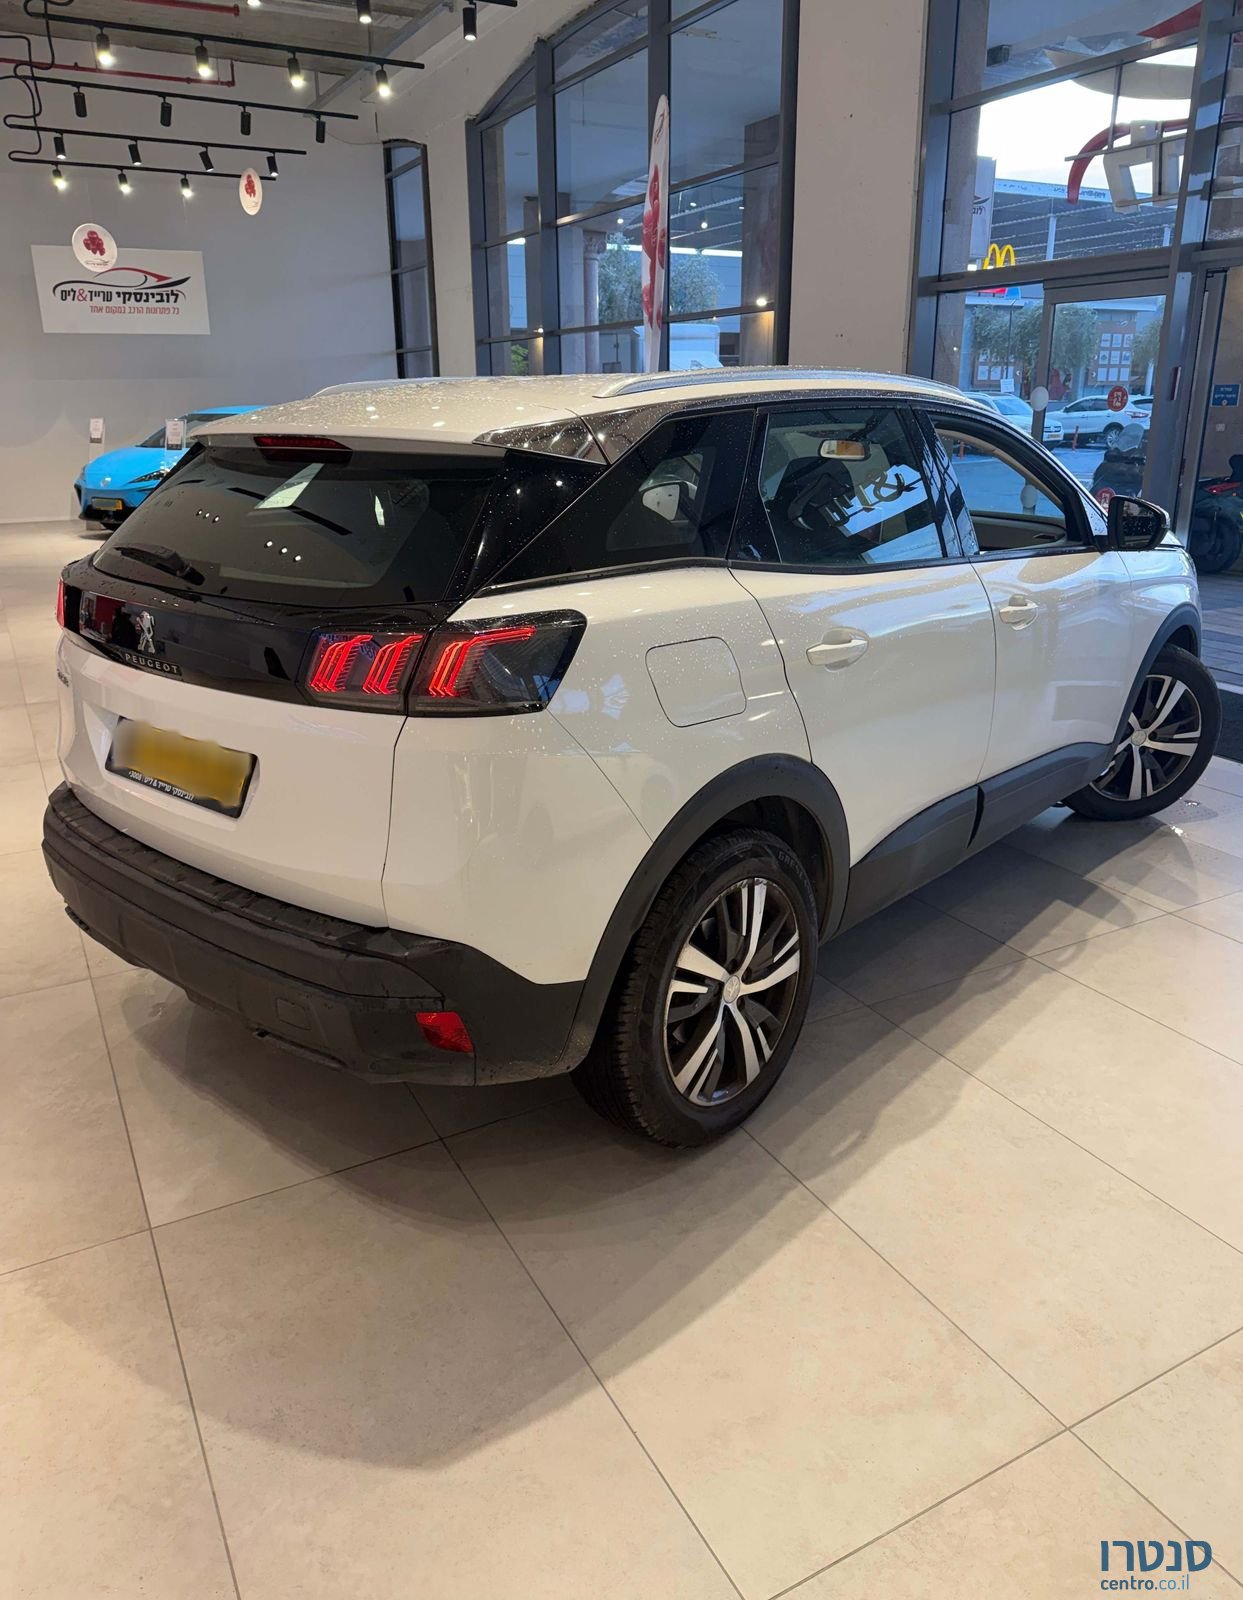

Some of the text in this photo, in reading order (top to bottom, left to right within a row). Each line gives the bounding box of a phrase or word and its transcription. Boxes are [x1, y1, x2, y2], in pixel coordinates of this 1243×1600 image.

[115, 289, 180, 304] לובינסקי
[89, 304, 180, 315] כל פתרונות הרכב במקום אחד
[125, 653, 177, 673] PEUGEOT
